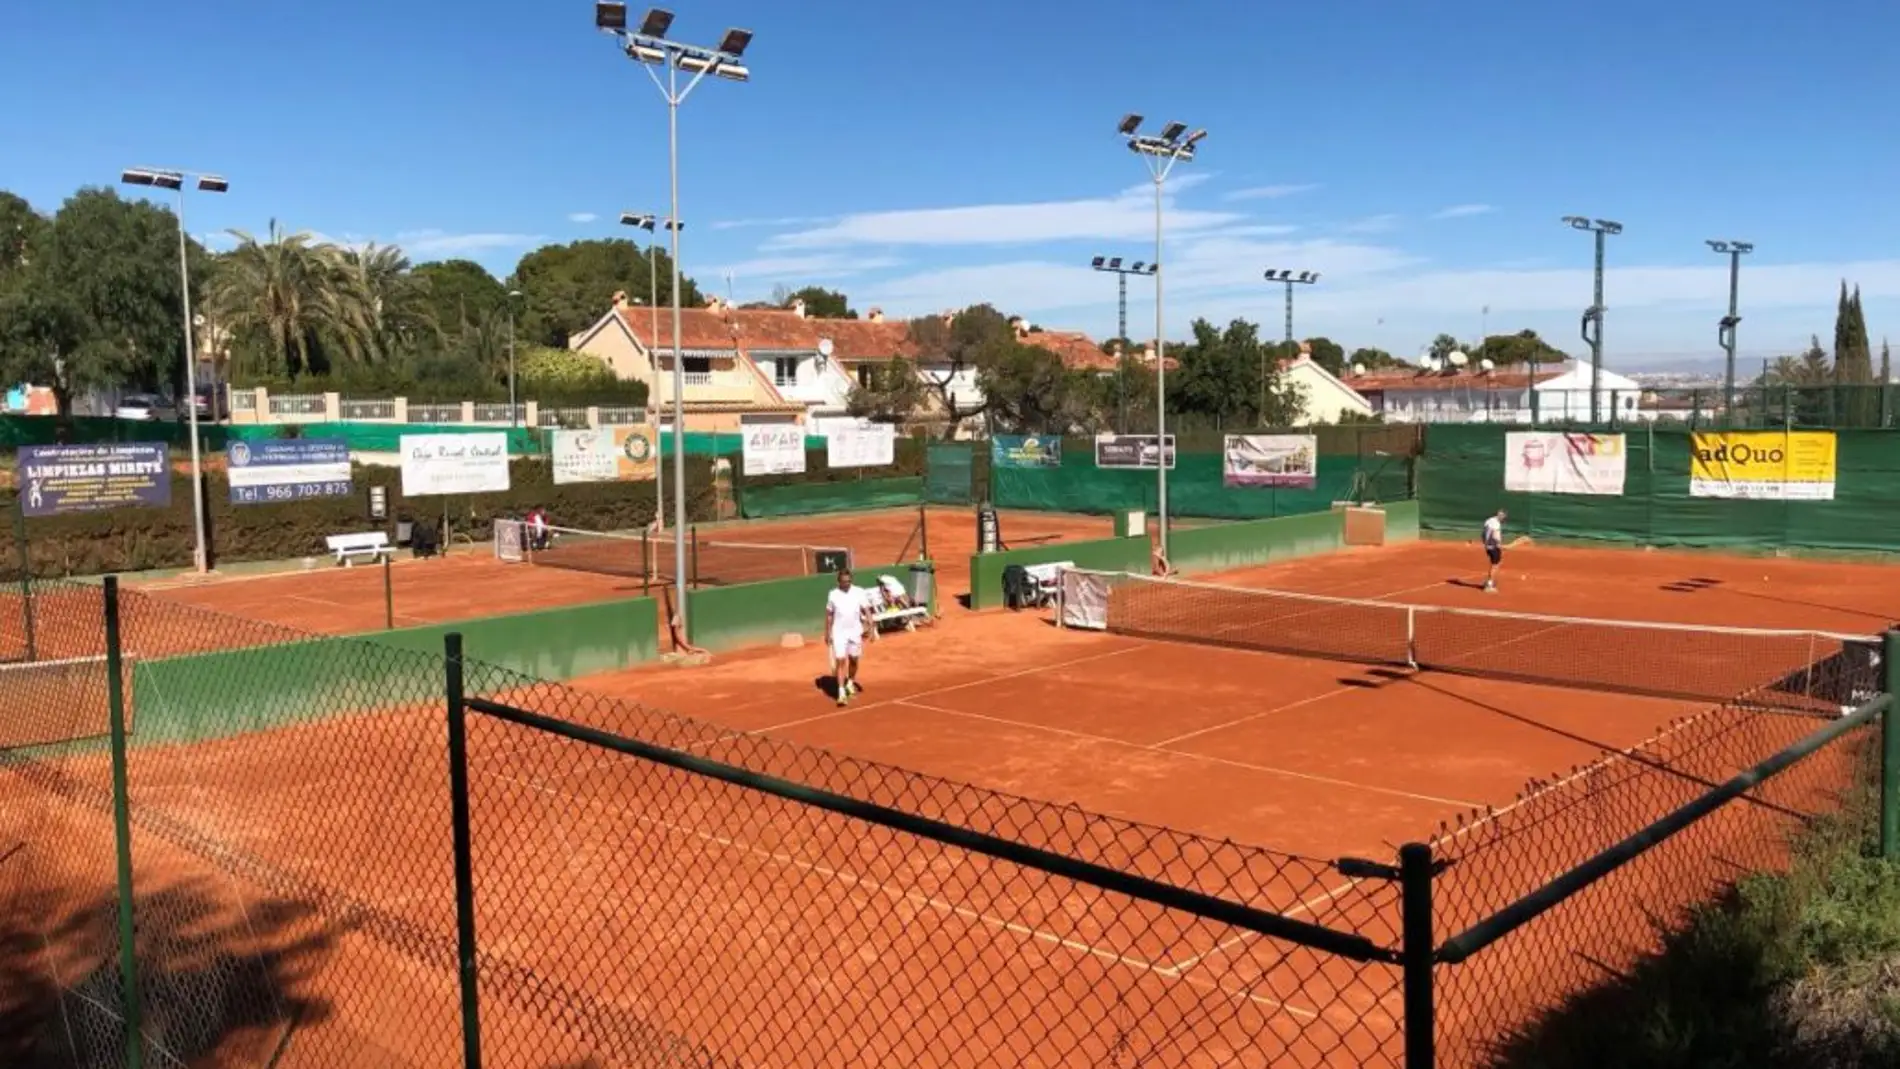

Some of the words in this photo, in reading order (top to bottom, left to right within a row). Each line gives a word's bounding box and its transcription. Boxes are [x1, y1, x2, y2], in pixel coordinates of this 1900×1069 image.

[27, 463, 106, 477] LIMPIEZAS
[108, 461, 162, 474] MIRETE
[266, 485, 292, 498] 966
[298, 483, 320, 496] 702
[325, 482, 347, 495] 875
